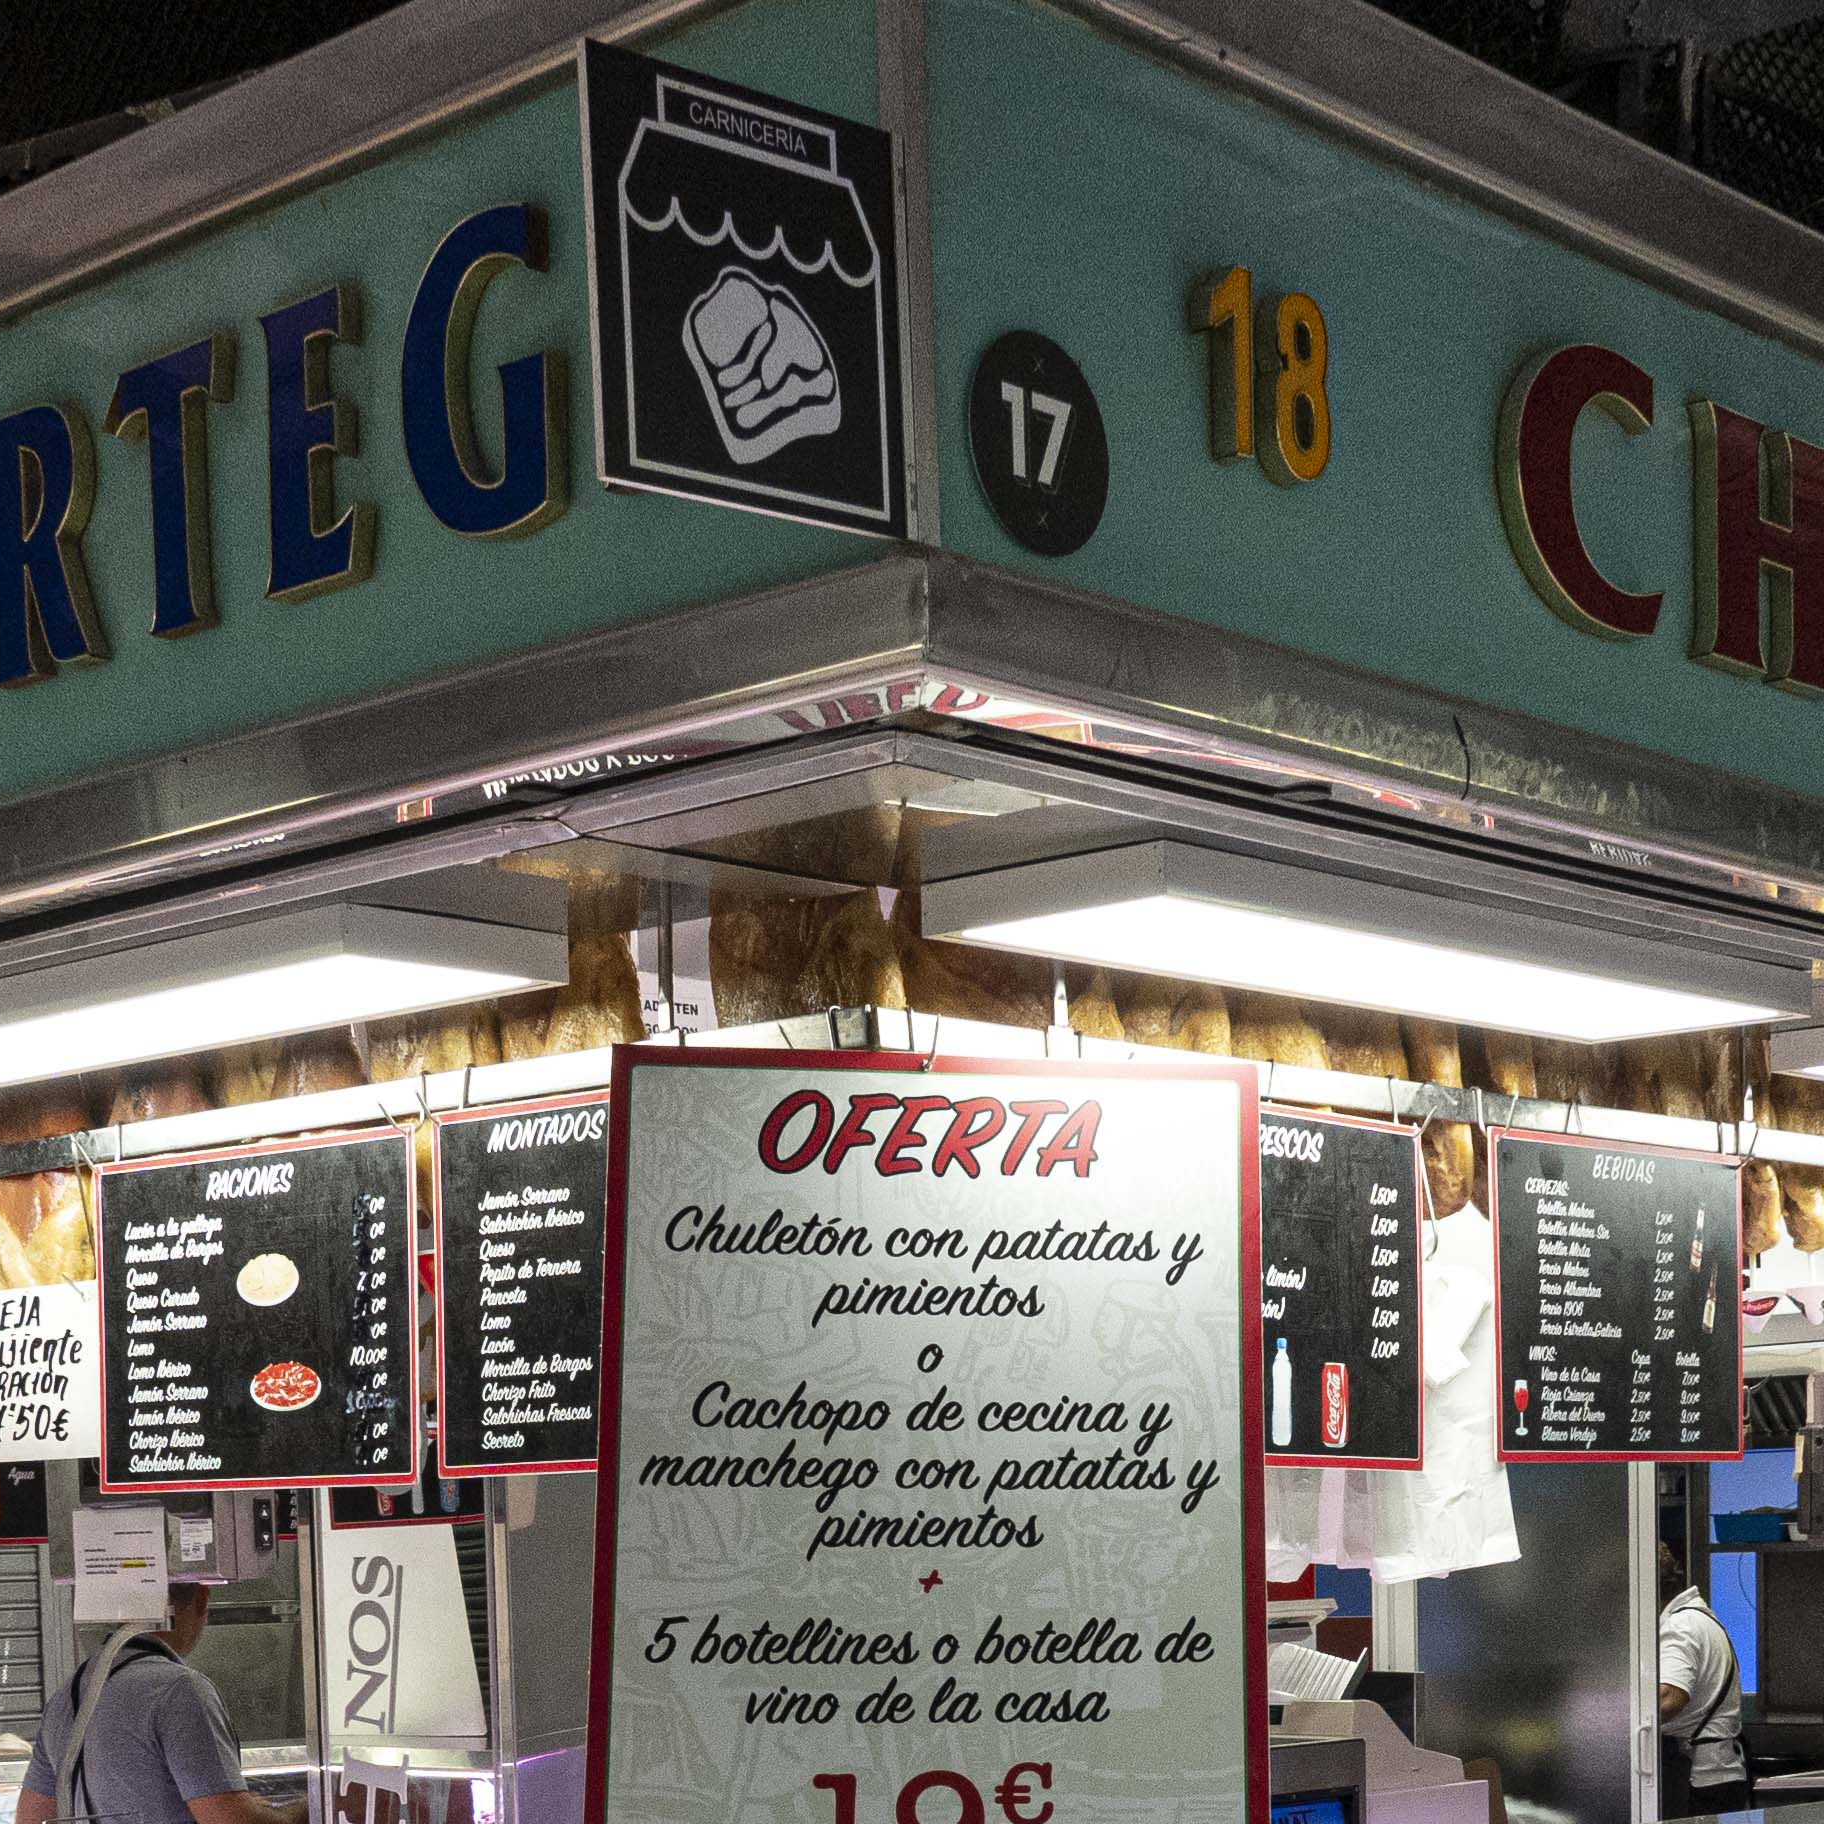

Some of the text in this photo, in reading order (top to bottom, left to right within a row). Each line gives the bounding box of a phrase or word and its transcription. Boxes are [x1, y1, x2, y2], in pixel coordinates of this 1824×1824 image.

[687, 101, 808, 157] CARNICERÍA
[1187, 266, 1331, 487] 18
[1001, 379, 1073, 494] 17
[487, 1108, 607, 1154] MONTADOS
[757, 1089, 1104, 1180] OFERTA
[206, 1161, 295, 1201] RACIONES
[1592, 1154, 1655, 1184] BEBIDAS
[478, 1186, 571, 1211] Jamón Serrano
[478, 1206, 585, 1235] Salchichón Ibérico
[479, 1239, 516, 1262] Queso
[665, 1204, 1204, 1285] Chuletón con patatas y
[125, 1267, 159, 1290] Queso
[479, 1257, 582, 1286] Pepito de Ternera
[1266, 1264, 1307, 1290] limón)
[126, 1285, 200, 1314] Queso Curado
[479, 1285, 527, 1307] Panceta
[812, 1275, 1044, 1327] pimientos
[1563, 1301, 1585, 1317] 1906
[126, 1312, 208, 1334] Jamón Serrano
[480, 1312, 512, 1331] Lomo
[127, 1338, 155, 1357] Lomo
[480, 1336, 516, 1355] Lacón
[917, 1342, 945, 1374] o
[1631, 1349, 1651, 1368] Copa
[127, 1358, 192, 1380] Lomo Ibérico
[481, 1353, 594, 1382] Morcilla de Burgos
[128, 1382, 209, 1404] Jamón Serrano
[482, 1379, 557, 1409] Chorizo Frito
[128, 1405, 201, 1427] Jamón Ibérico
[481, 1402, 593, 1426] Salchichas Frescas
[692, 1380, 1173, 1456] Cachopo de cecina y
[129, 1428, 205, 1458] Chorizo Ibérico
[481, 1430, 525, 1450] Secreto
[7, 1466, 35, 1487] Agua
[128, 1451, 222, 1474] Salchichón Ibérico
[639, 1439, 1221, 1513] manchego con patatas y
[807, 1507, 1044, 1561] pimientos
[644, 1615, 1215, 1665] 5 botellines o botella de
[744, 1675, 1111, 1725] vino de la casa
